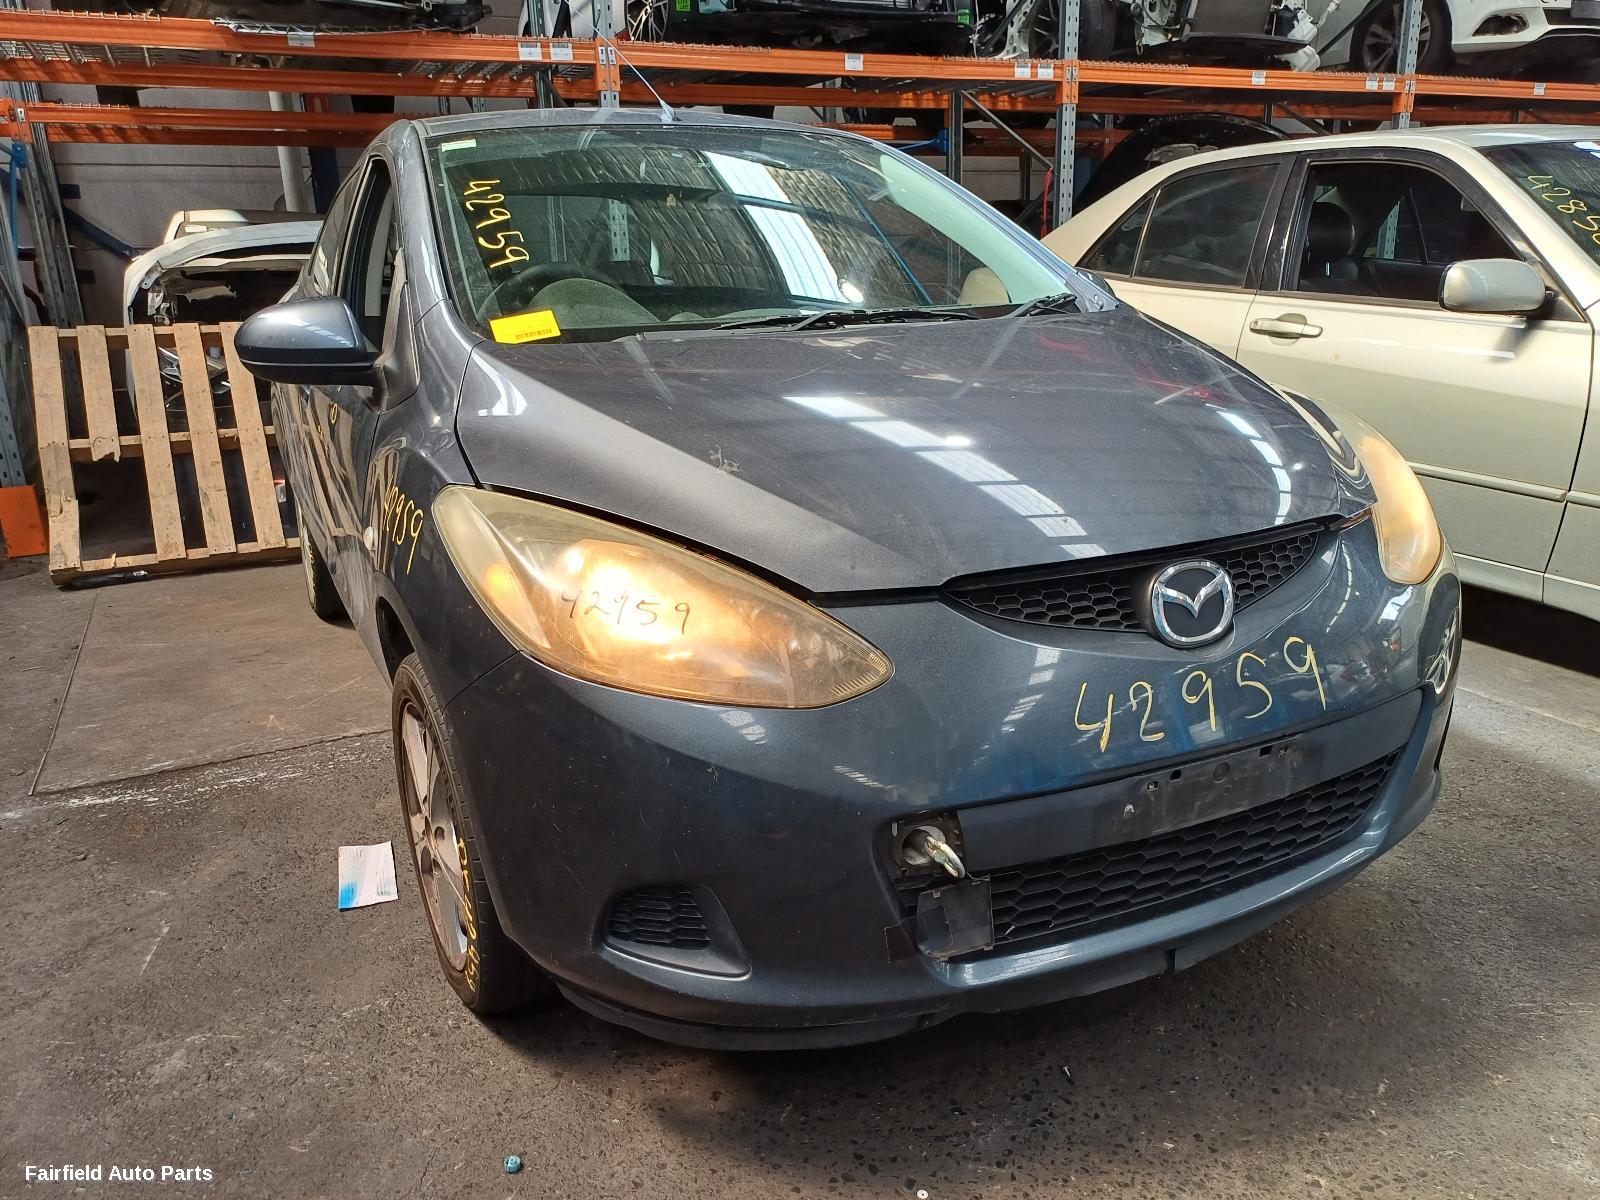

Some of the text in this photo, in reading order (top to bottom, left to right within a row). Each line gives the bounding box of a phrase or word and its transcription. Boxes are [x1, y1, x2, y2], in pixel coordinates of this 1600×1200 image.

[463, 179, 530, 269] 42959
[560, 589, 691, 634] 42959
[1074, 636, 1327, 753] 42959
